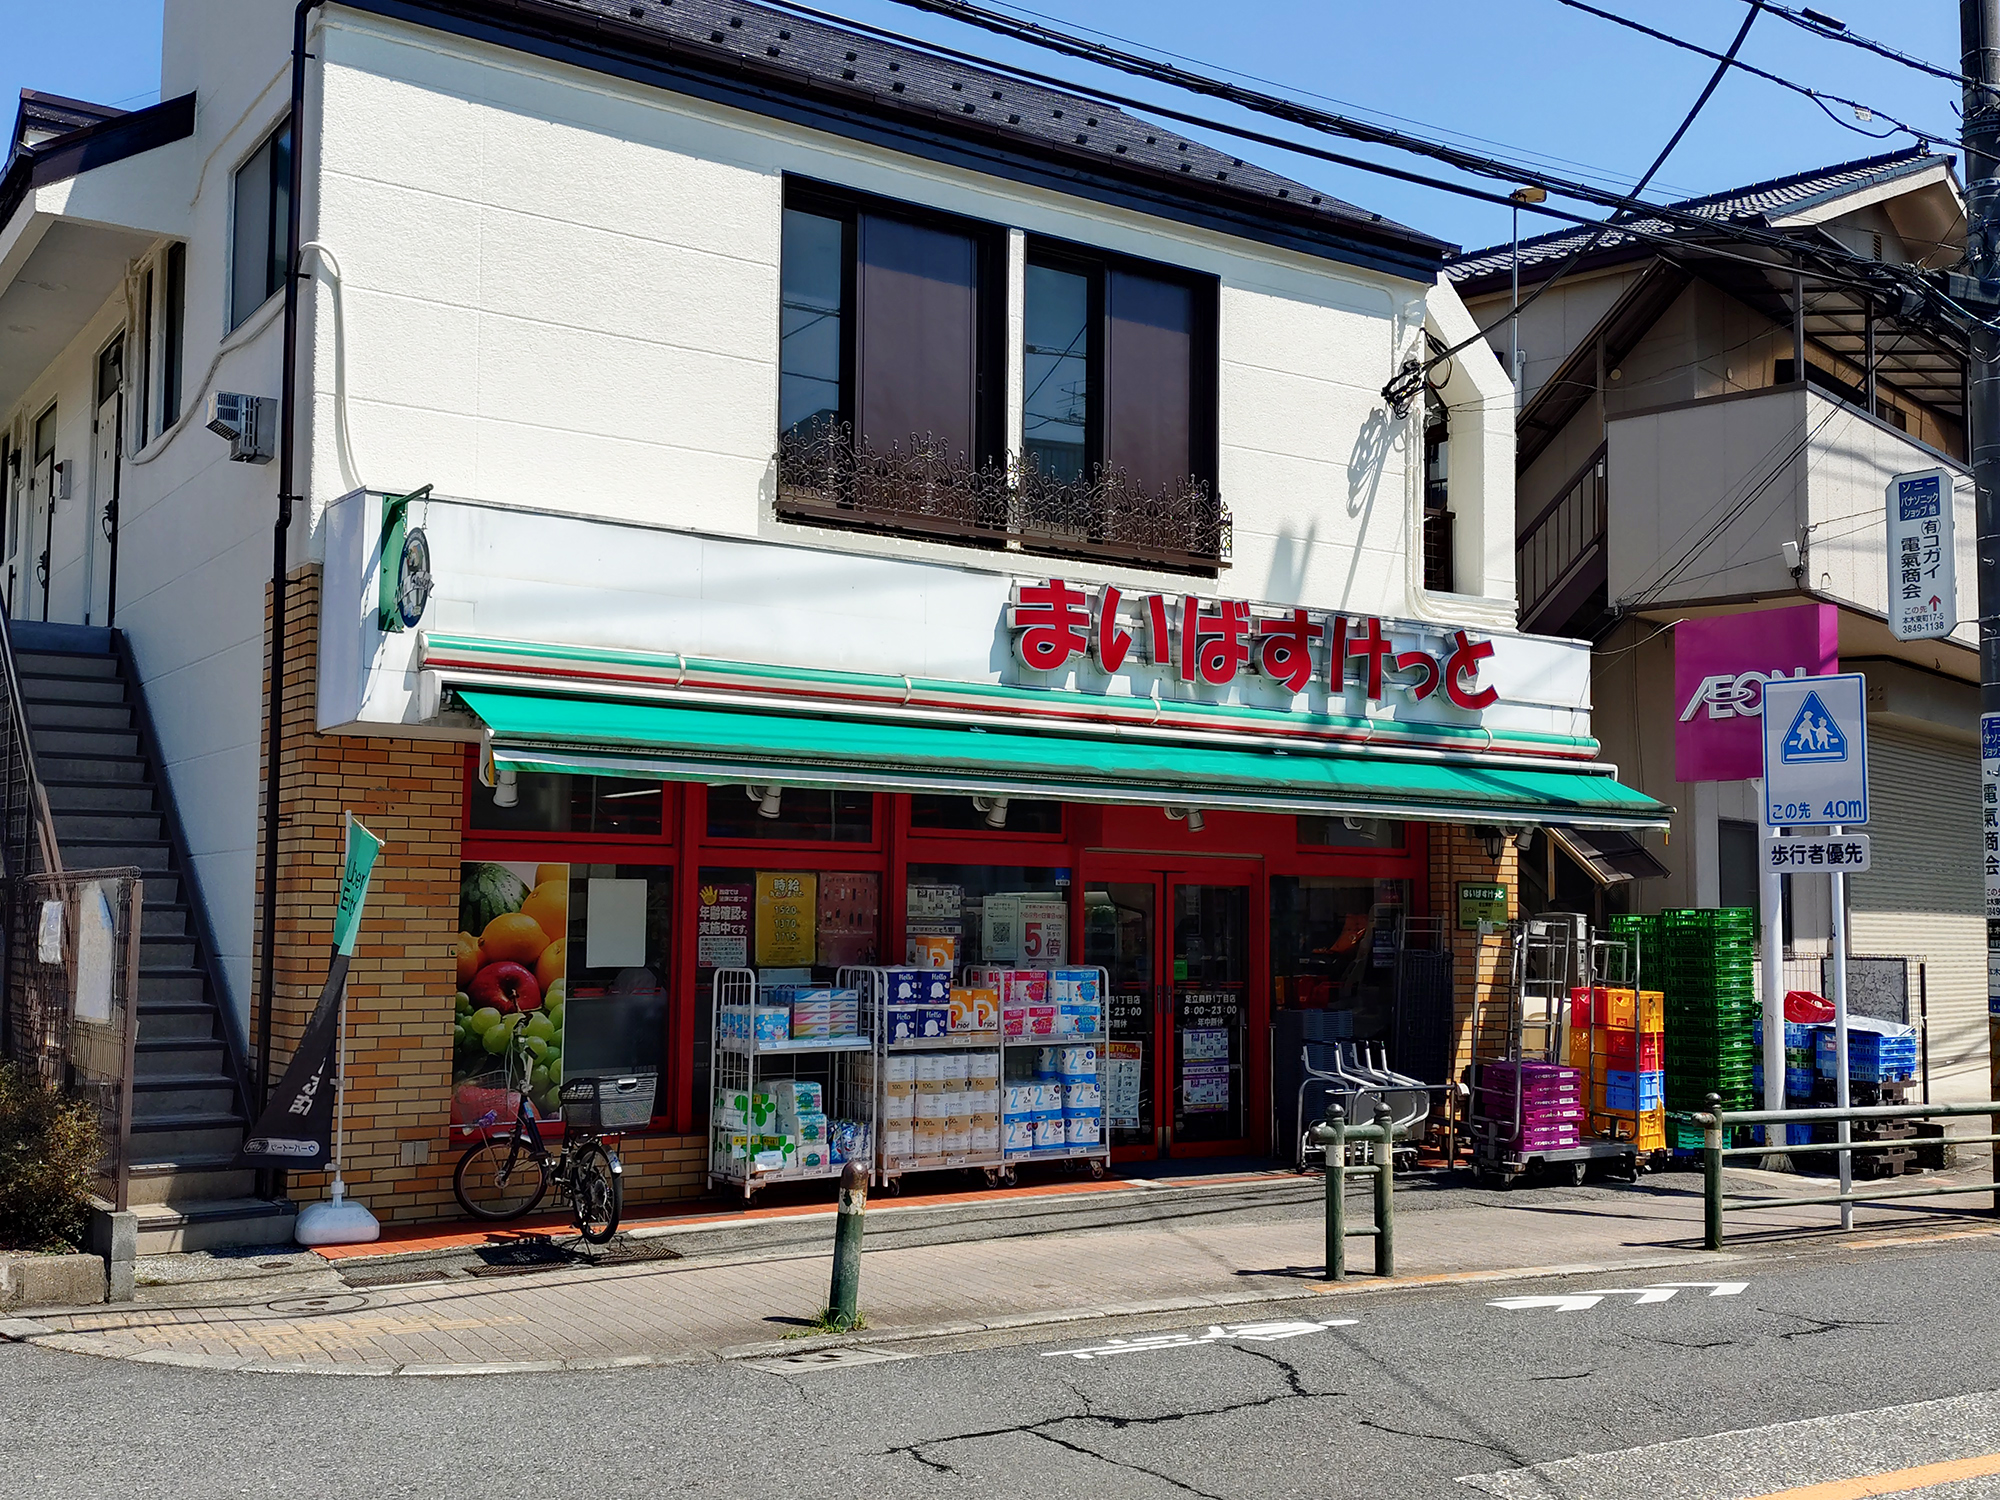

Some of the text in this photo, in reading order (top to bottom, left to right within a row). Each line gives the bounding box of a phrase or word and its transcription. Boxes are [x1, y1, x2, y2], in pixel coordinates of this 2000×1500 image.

[1902, 481, 1937, 494] ソニー
[1901, 492, 1939, 507] パナソニック
[1901, 537, 1922, 600] 電氣商会
[1902, 621, 1944, 634] 3849-1138
[1011, 578, 1499, 711] まいばすけっと
[1679, 667, 1807, 721] AEO
[1772, 800, 1862, 819] この先 40m
[1771, 842, 1863, 865] 歩行者優先
[773, 878, 800, 891] 時給
[699, 905, 747, 920] 年齢確認を
[1025, 922, 1042, 957] 5
[1197, 1017, 1224, 1027] 年中無休
